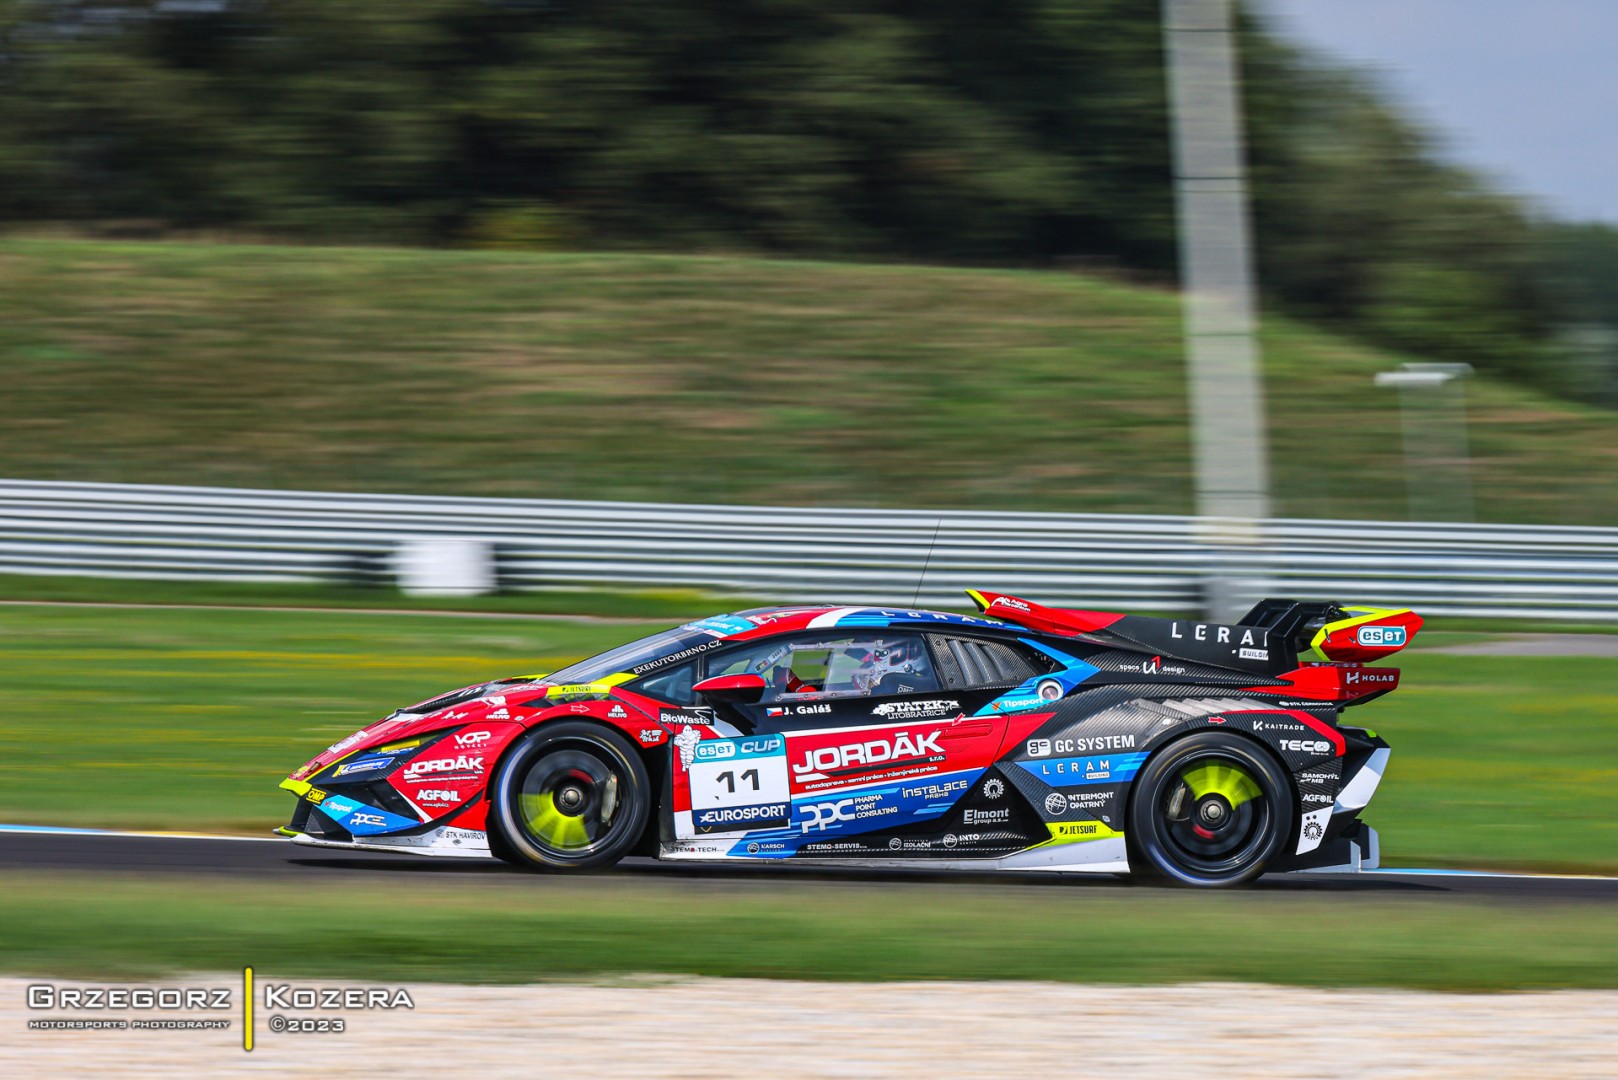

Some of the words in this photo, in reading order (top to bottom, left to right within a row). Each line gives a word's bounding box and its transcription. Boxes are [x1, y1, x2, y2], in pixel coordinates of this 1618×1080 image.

[633, 640, 722, 674] EXEKUTORBRNO.CZ
[1362, 674, 1394, 682] HOLAB
[783, 706, 793, 715] J.
[798, 703, 832, 715] Galáš
[1003, 699, 1043, 708] Tipsport
[660, 713, 710, 725] BioWaste
[1265, 723, 1304, 731] KAITRADE
[454, 731, 491, 745] VOP
[1055, 739, 1074, 753] GC
[1077, 735, 1135, 750] SYSTEM
[741, 739, 781, 753] CUP
[1280, 739, 1330, 752] TECO
[716, 769, 760, 793] 11
[308, 790, 325, 800] OMP
[416, 789, 462, 802] AGFOIL
[855, 795, 883, 804] PHARMA
[1302, 794, 1334, 803] AGFOIL
[856, 803, 875, 811] POINT
[857, 807, 898, 819] CONSULTING
[707, 805, 786, 822] EUROSPORT
[799, 799, 855, 833] PPC
[964, 808, 1009, 821] Elmont
[1069, 825, 1097, 834] JETSURF
